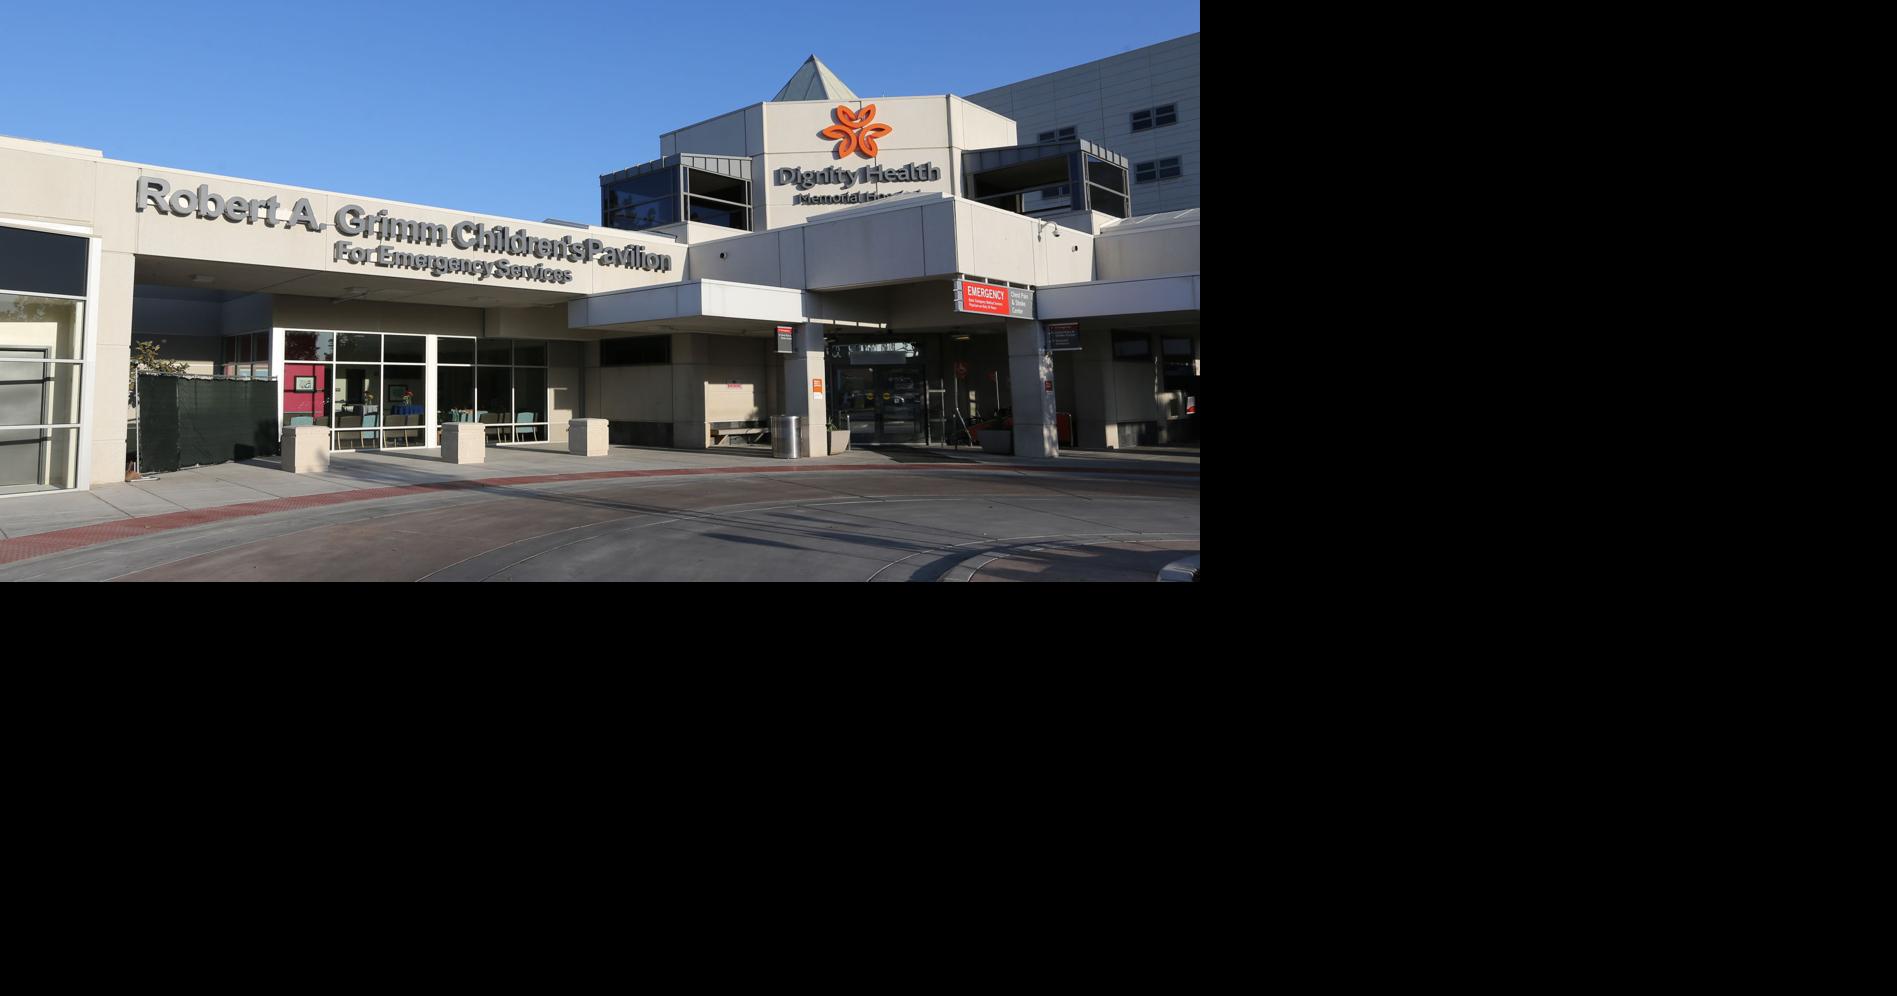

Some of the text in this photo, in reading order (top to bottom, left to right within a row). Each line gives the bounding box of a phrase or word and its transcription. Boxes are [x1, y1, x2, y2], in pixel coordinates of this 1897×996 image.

[773, 161, 941, 191] Dignity Health
[793, 189, 860, 206] Memorial
[136, 176, 672, 273] Robert A. Grimm Children's Pavilion
[333, 240, 573, 284] For Emergency Services
[968, 286, 1004, 300] EMERGENCY
